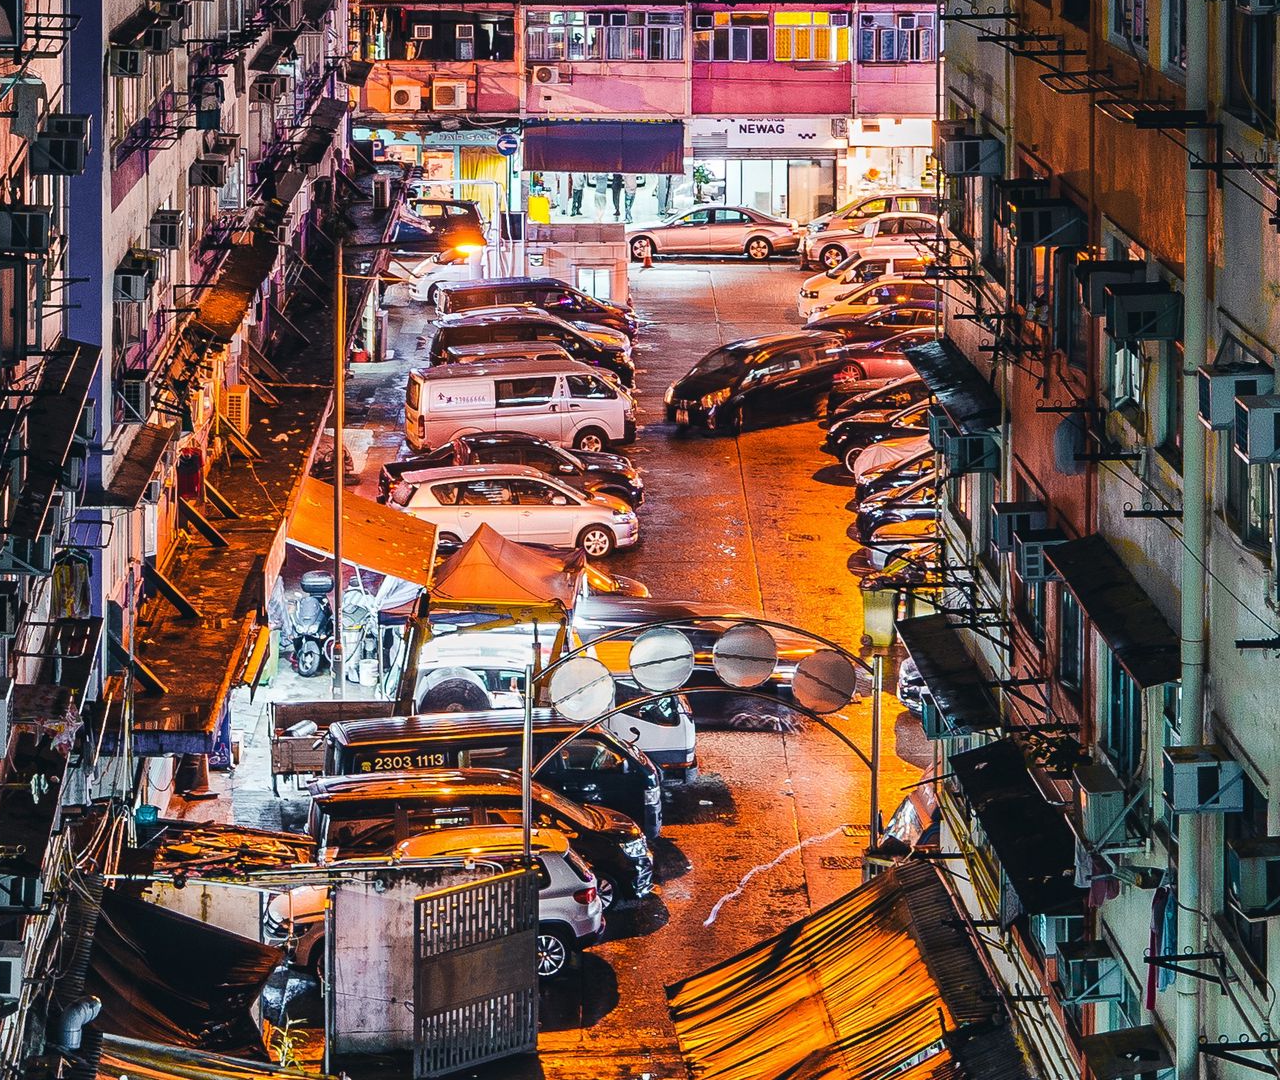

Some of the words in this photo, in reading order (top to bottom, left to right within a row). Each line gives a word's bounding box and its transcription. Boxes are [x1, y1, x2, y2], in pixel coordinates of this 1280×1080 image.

[739, 124, 784, 134] NEWAG
[467, 133, 497, 141] SALO
[374, 756, 412, 770] 2303
[416, 754, 444, 766] 1113
